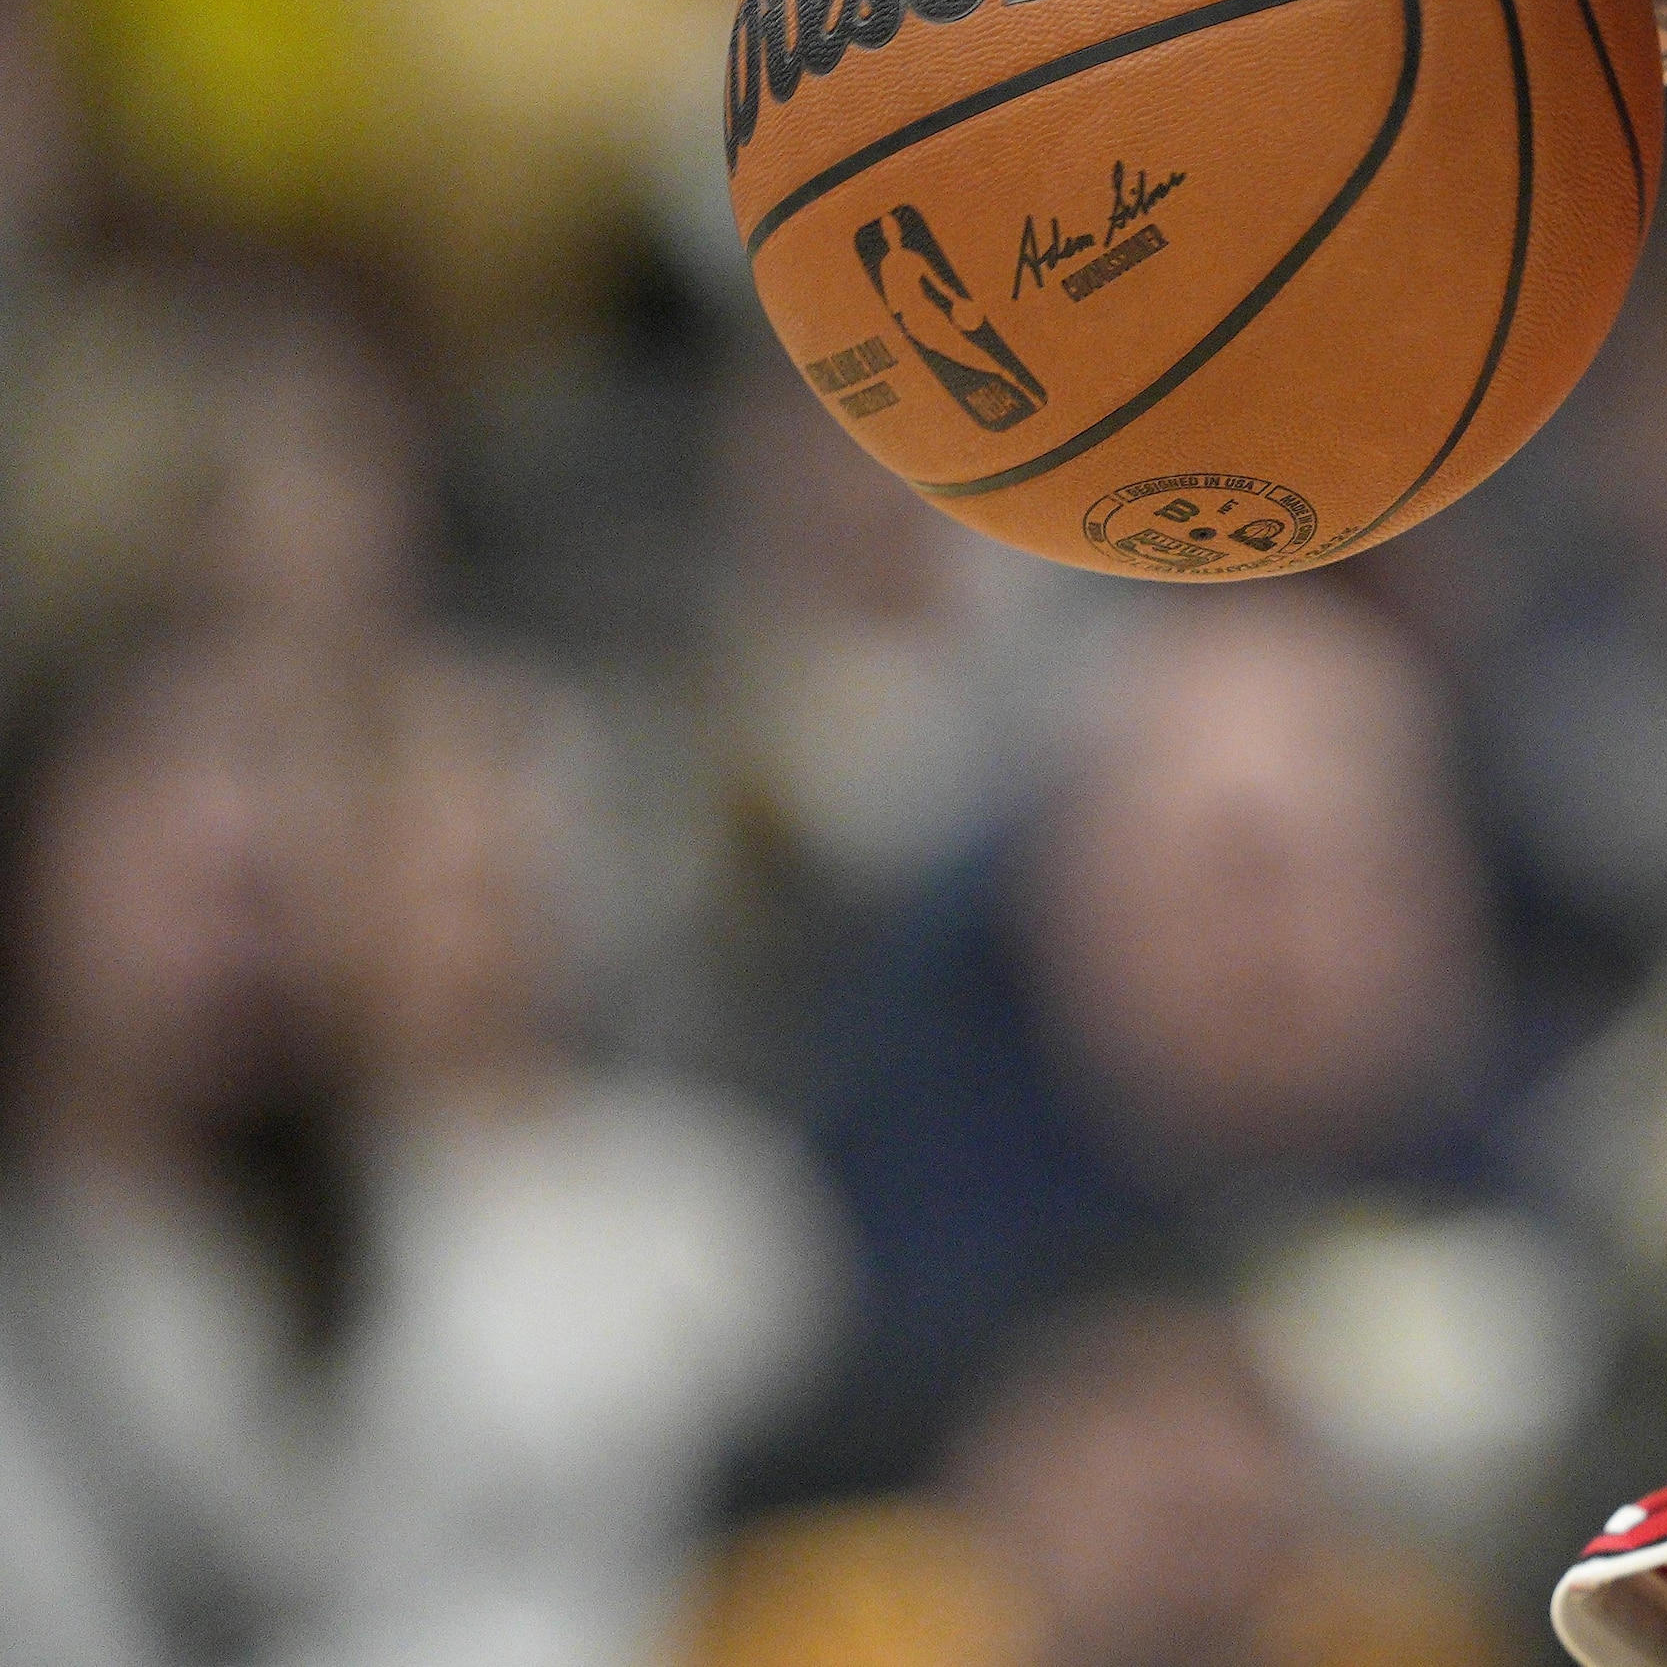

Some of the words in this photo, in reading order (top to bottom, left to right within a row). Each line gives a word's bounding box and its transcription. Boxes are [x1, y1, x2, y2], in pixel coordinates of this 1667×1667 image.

[1126, 476, 1199, 497] DESIGNED
[1203, 476, 1221, 487] IN
[1223, 476, 1255, 491] USA
[1280, 494, 1310, 516] MADE
